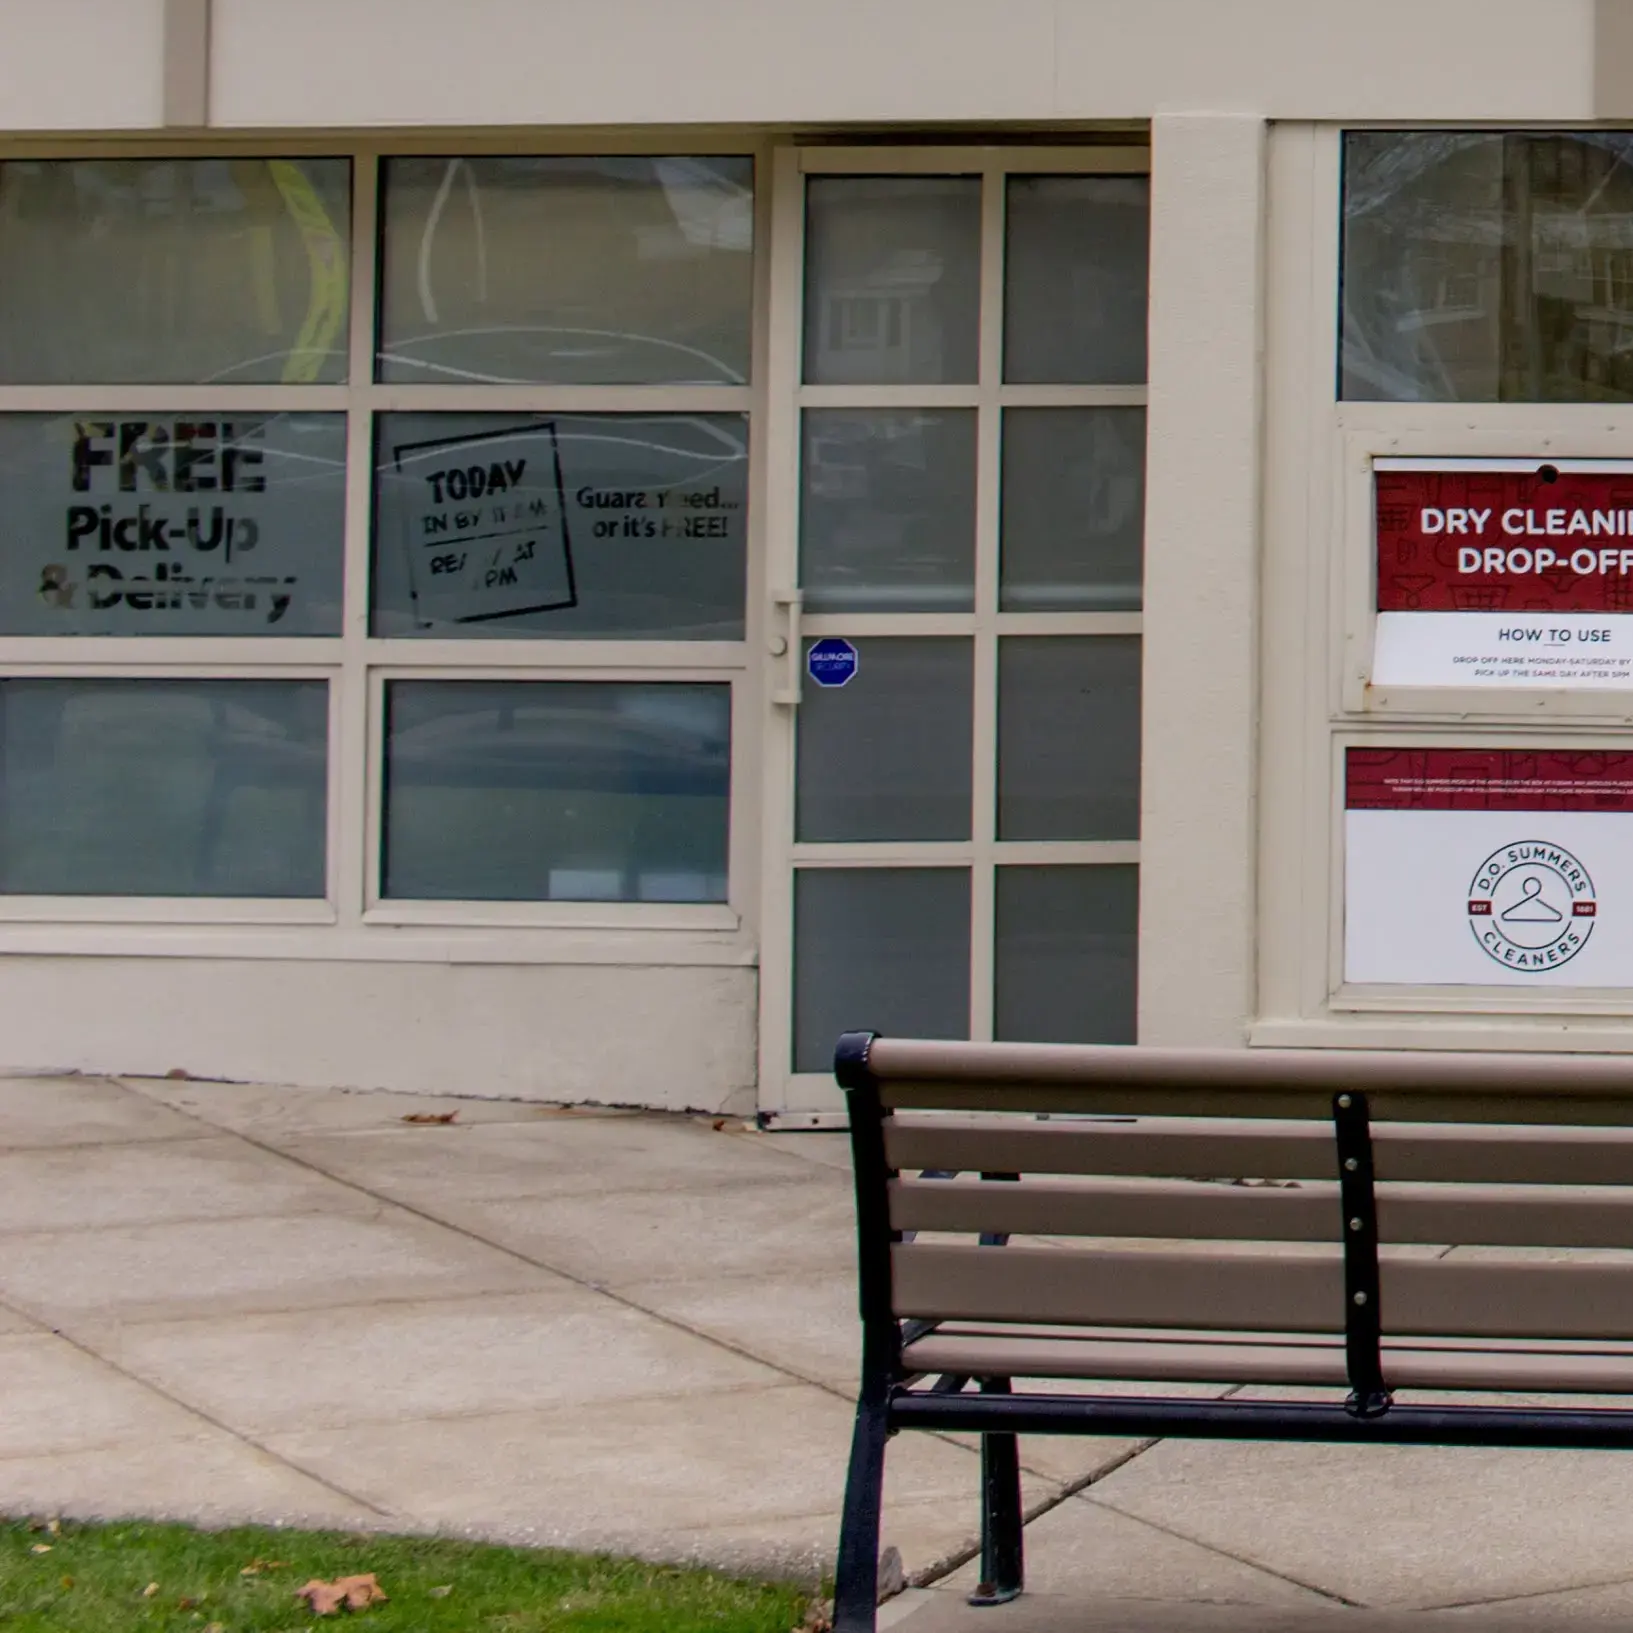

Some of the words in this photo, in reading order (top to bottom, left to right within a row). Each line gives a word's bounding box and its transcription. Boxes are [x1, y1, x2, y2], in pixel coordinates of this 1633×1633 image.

[72, 421, 267, 493] FREE
[426, 459, 527, 504] TODAY
[66, 504, 259, 564] Pick-Up
[421, 511, 448, 535] IN
[593, 520, 620, 538] or
[623, 516, 655, 538] it's
[1420, 508, 1491, 535] DRY
[87, 563, 298, 624] Delivery
[1498, 628, 1543, 643] HOW
[1548, 628, 1572, 643] TO
[1578, 628, 1612, 643] USE
[1453, 656, 1479, 664] DROP
[1481, 656, 1498, 664] OFF
[1501, 656, 1525, 665] HERE
[1497, 669, 1510, 677] UP
[1513, 669, 1529, 677] THE
[1532, 669, 1557, 678] SAME
[1559, 670, 1577, 678] DAY
[1580, 670, 1609, 678] AFTER
[1478, 862, 1505, 890] D.O.
[1507, 846, 1587, 892] SUMMERS
[1484, 931, 1580, 966] CLEANERS
